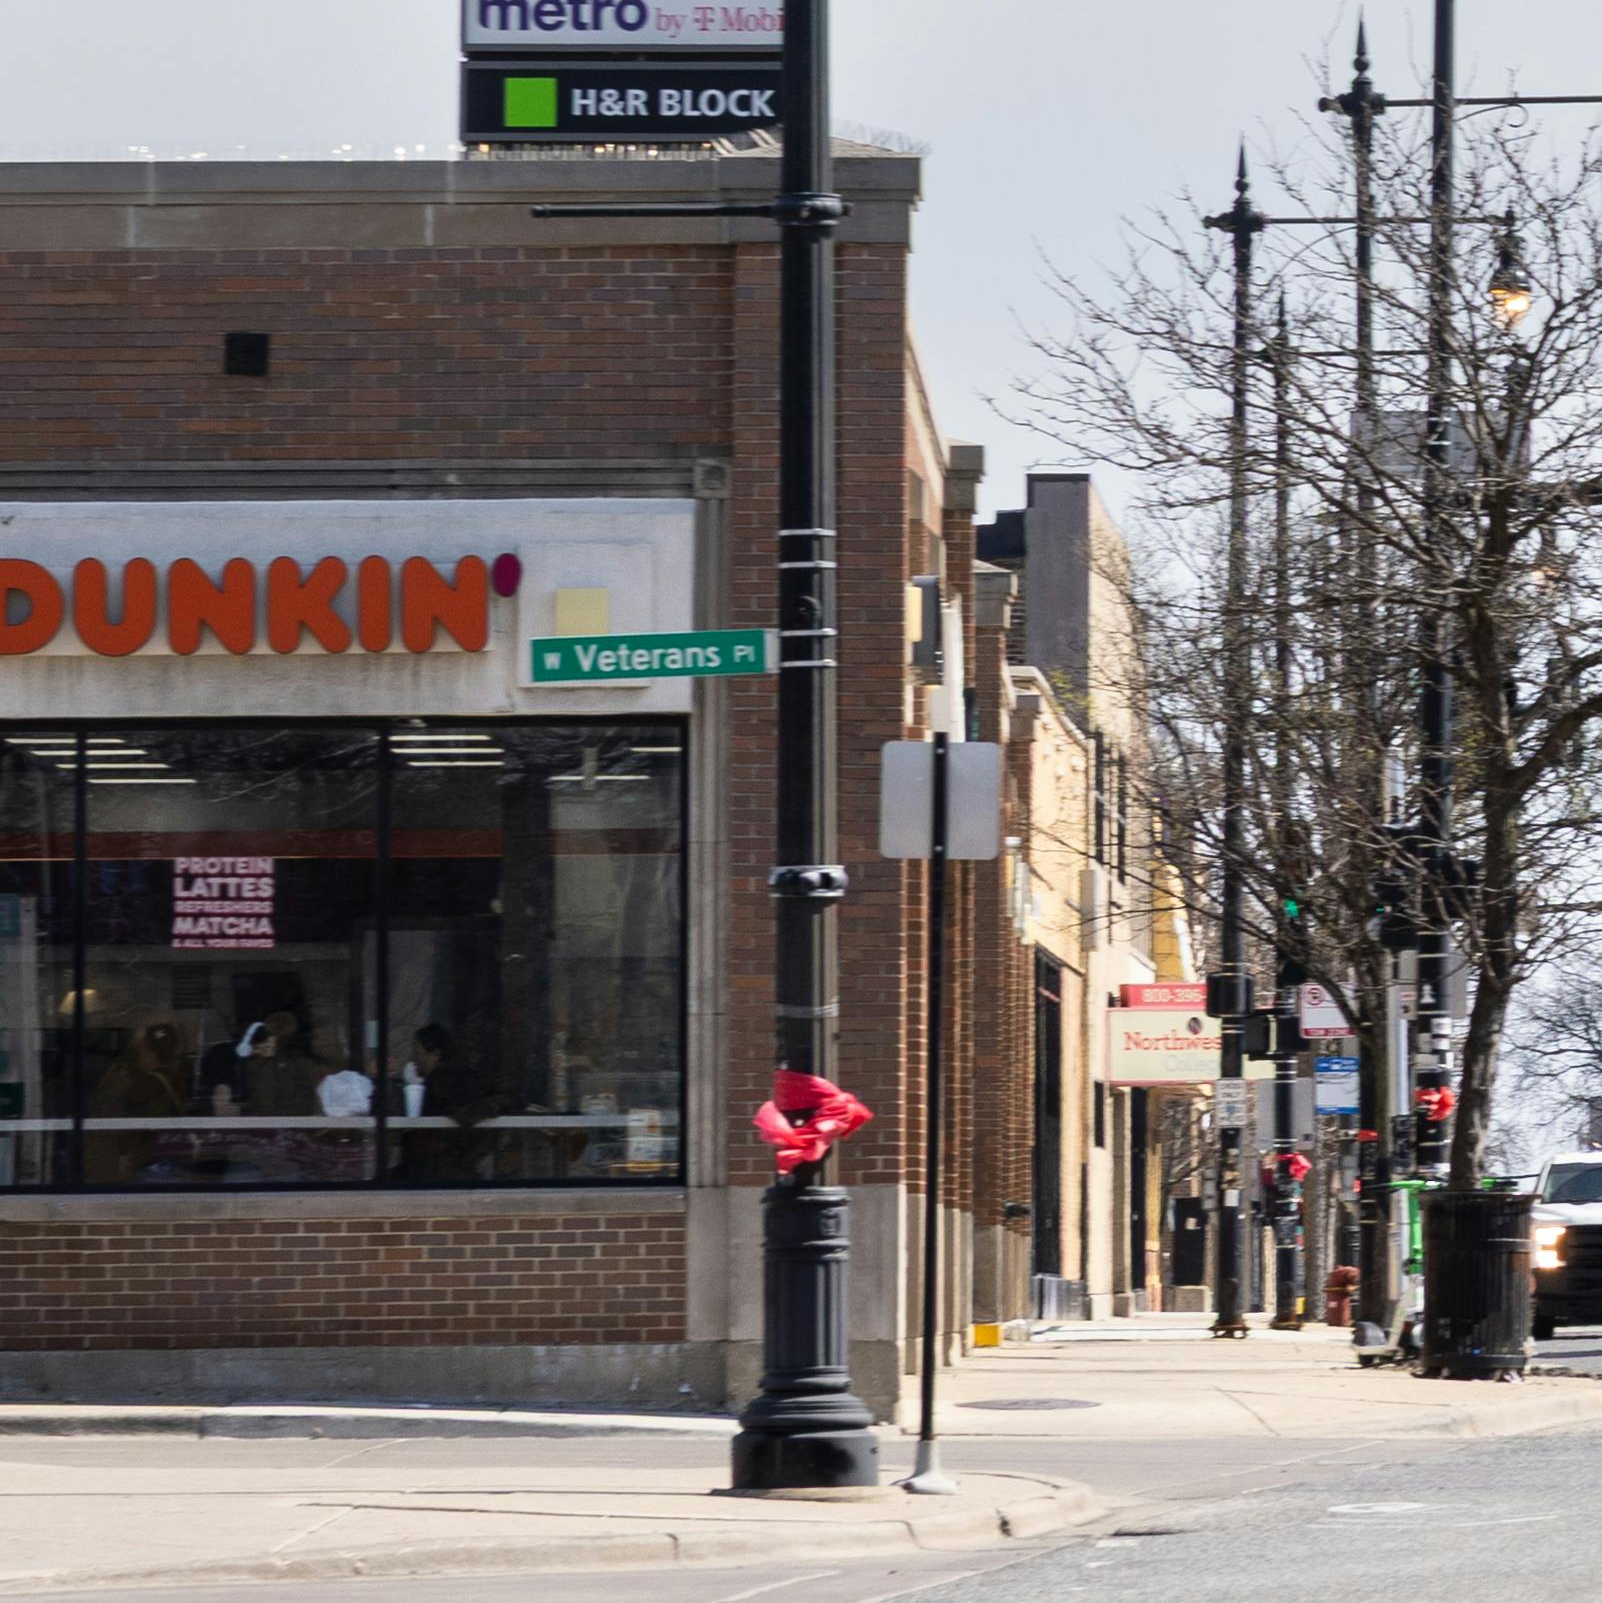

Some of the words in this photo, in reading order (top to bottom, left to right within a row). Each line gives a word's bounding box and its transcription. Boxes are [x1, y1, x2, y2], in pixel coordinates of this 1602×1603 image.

[655, 7, 686, 38] by
[571, 88, 649, 116] H&R
[658, 89, 775, 118] BLOCK
[543, 652, 562, 670] W
[574, 643, 722, 673] Veterans
[174, 856, 273, 875] PROTEIN
[174, 877, 275, 897] LATTES
[172, 917, 274, 935] MATCHA
